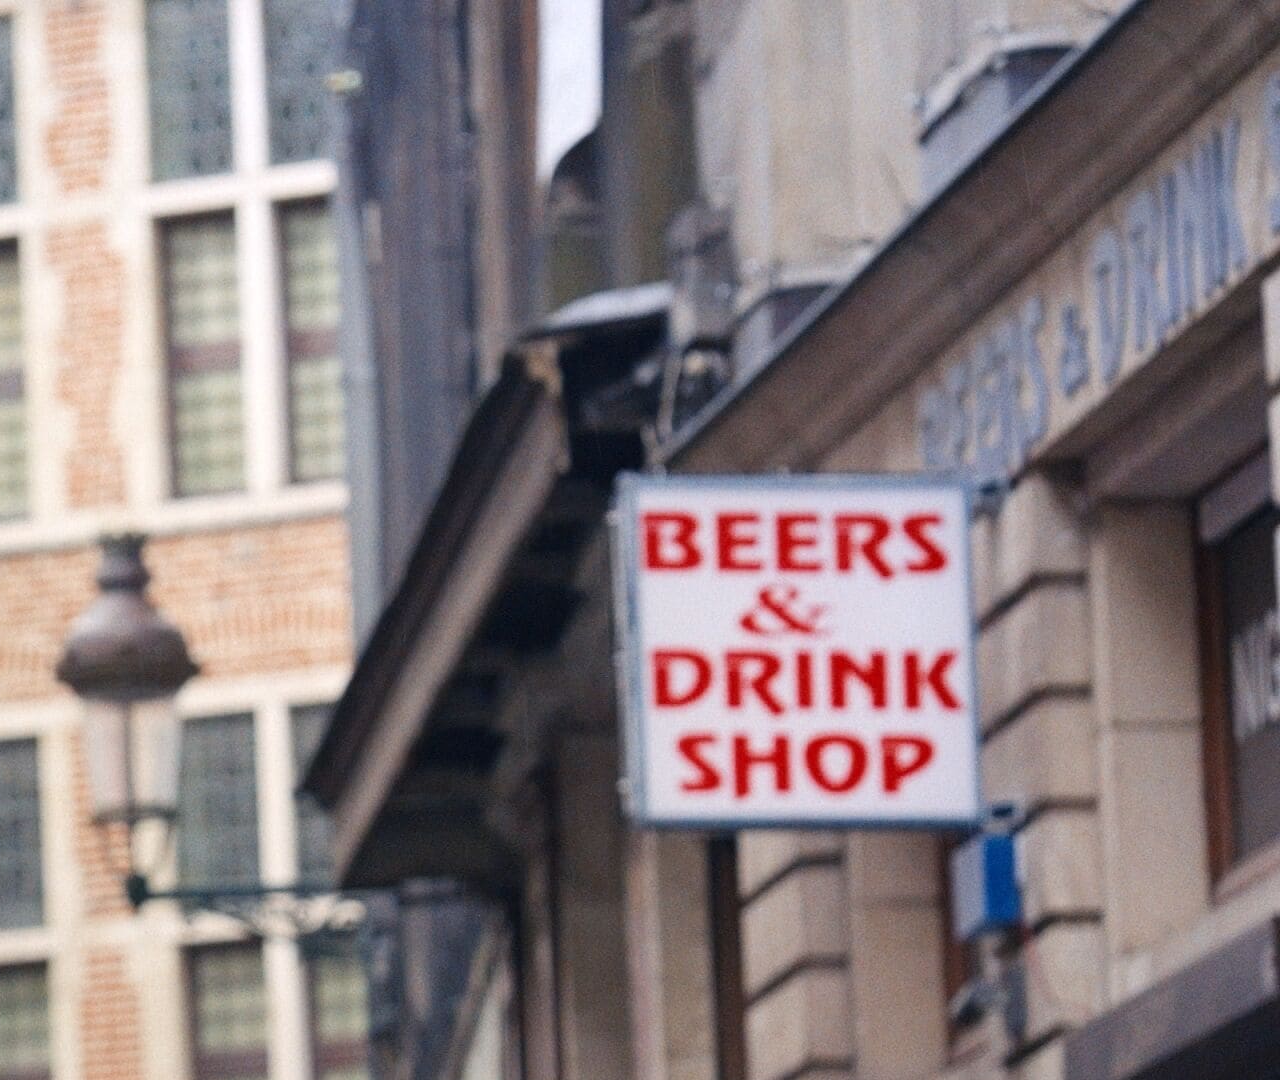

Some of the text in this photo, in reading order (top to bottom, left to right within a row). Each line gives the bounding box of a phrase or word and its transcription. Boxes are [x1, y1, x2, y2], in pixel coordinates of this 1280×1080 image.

[1092, 117, 1248, 388] DRINK
[642, 512, 948, 580] BEERS
[739, 585, 832, 637] &
[652, 650, 962, 716] DRINK
[676, 731, 937, 800] SHOP
